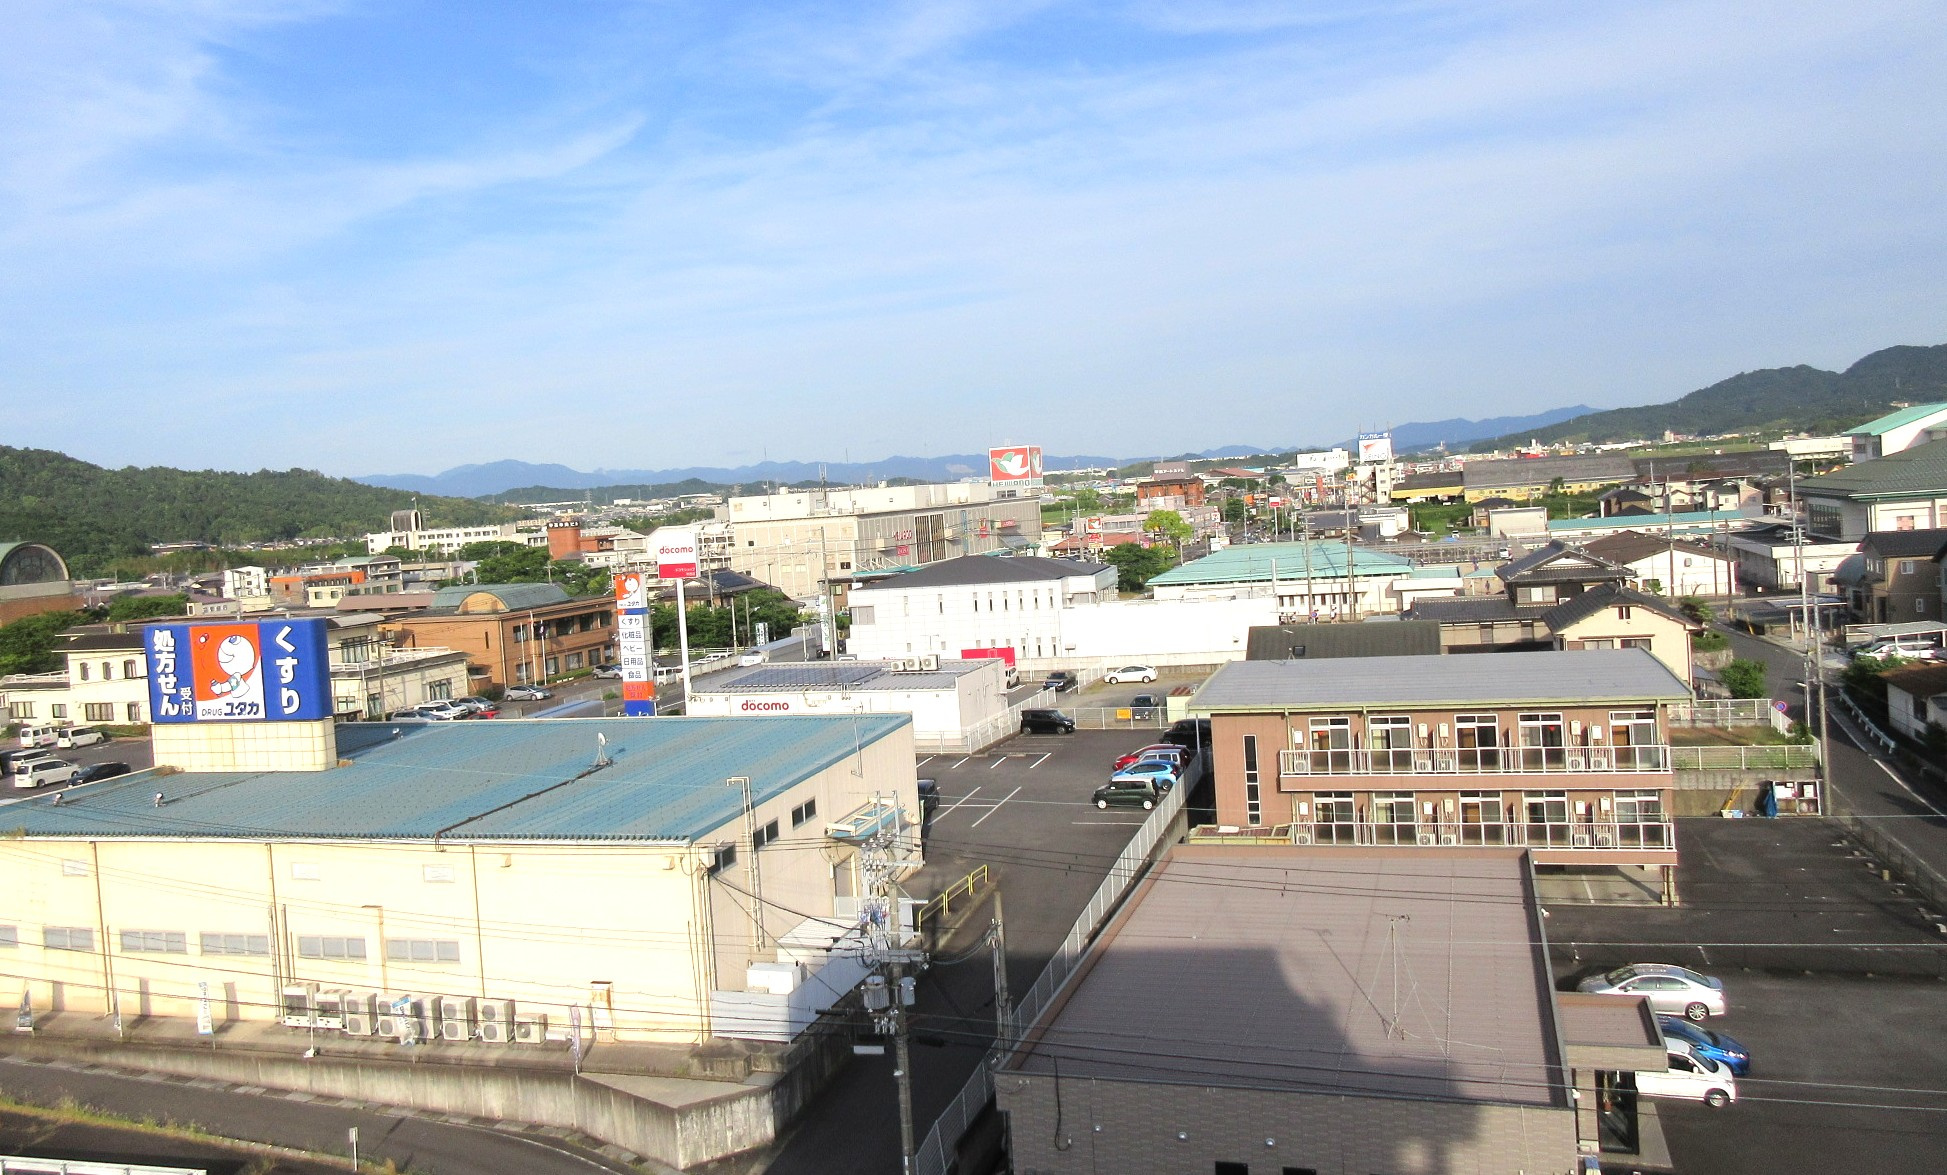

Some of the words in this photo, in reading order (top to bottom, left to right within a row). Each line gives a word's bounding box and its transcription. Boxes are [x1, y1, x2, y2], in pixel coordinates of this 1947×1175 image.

[659, 545, 694, 555] docomo
[621, 617, 640, 626] くすり
[621, 630, 642, 639] 化粧品
[623, 657, 644, 666] 日用品
[153, 629, 180, 717] 処方せん
[275, 625, 300, 715] くすり
[627, 670, 642, 679] 食品
[180, 686, 193, 717] 受付
[741, 699, 790, 711] docomo
[201, 707, 223, 717] DRUG
[223, 700, 260, 717] ユタカ
